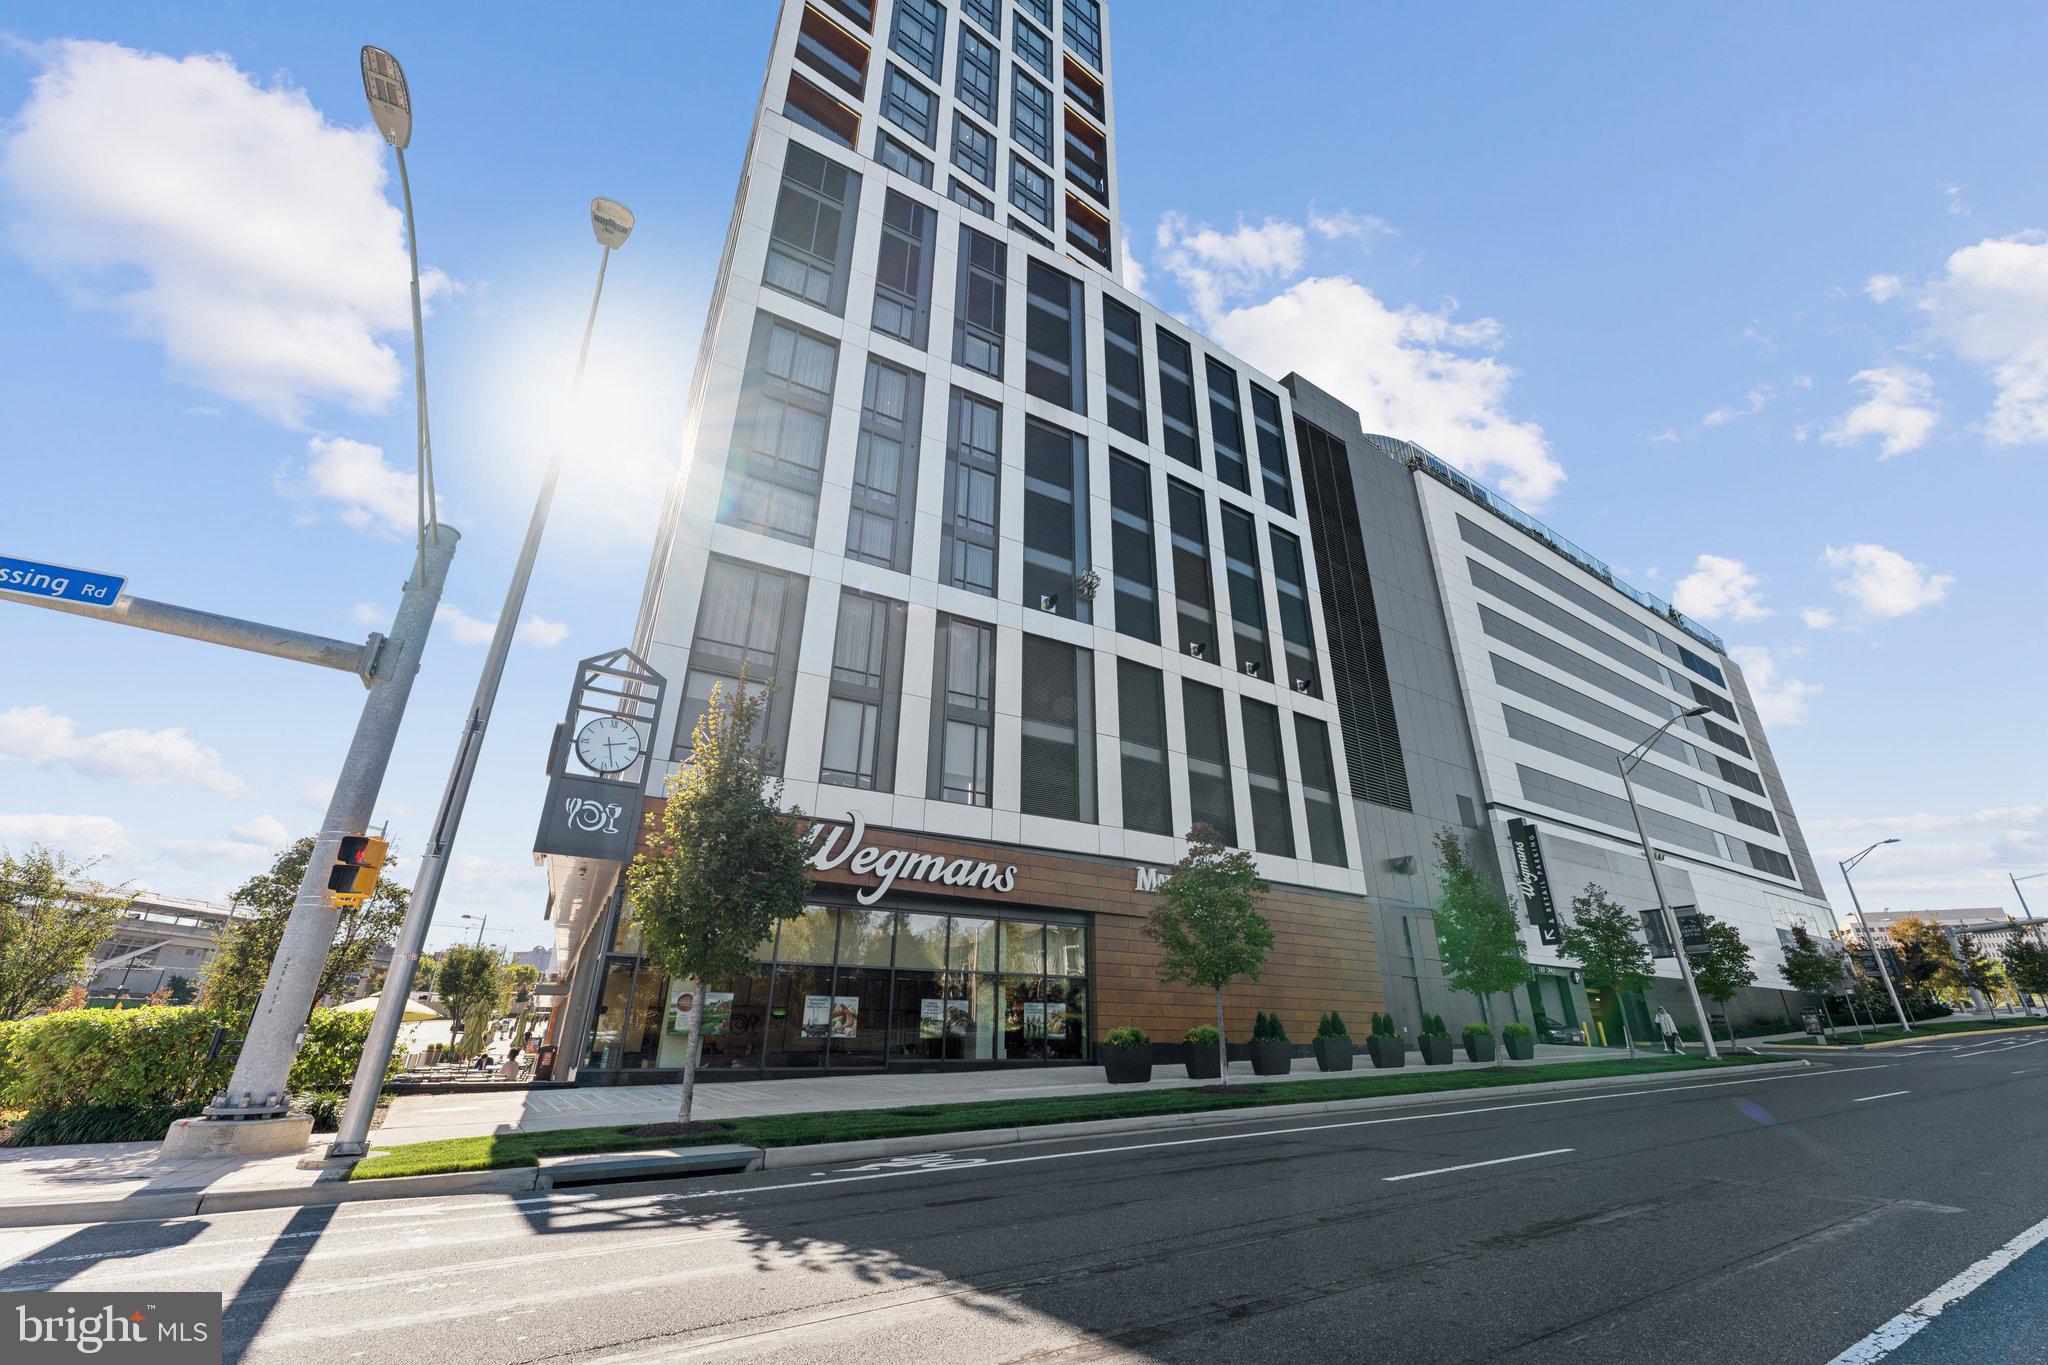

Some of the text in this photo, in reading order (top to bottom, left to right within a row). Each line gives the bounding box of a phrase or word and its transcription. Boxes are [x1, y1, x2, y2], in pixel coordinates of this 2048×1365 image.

[81, 583, 108, 599] Rd
[798, 809, 1018, 905] Wegmans
[1515, 841, 1538, 900] Wegmans
[1529, 835, 1543, 875] PARKING
[1539, 881, 1551, 912] RETAIL
